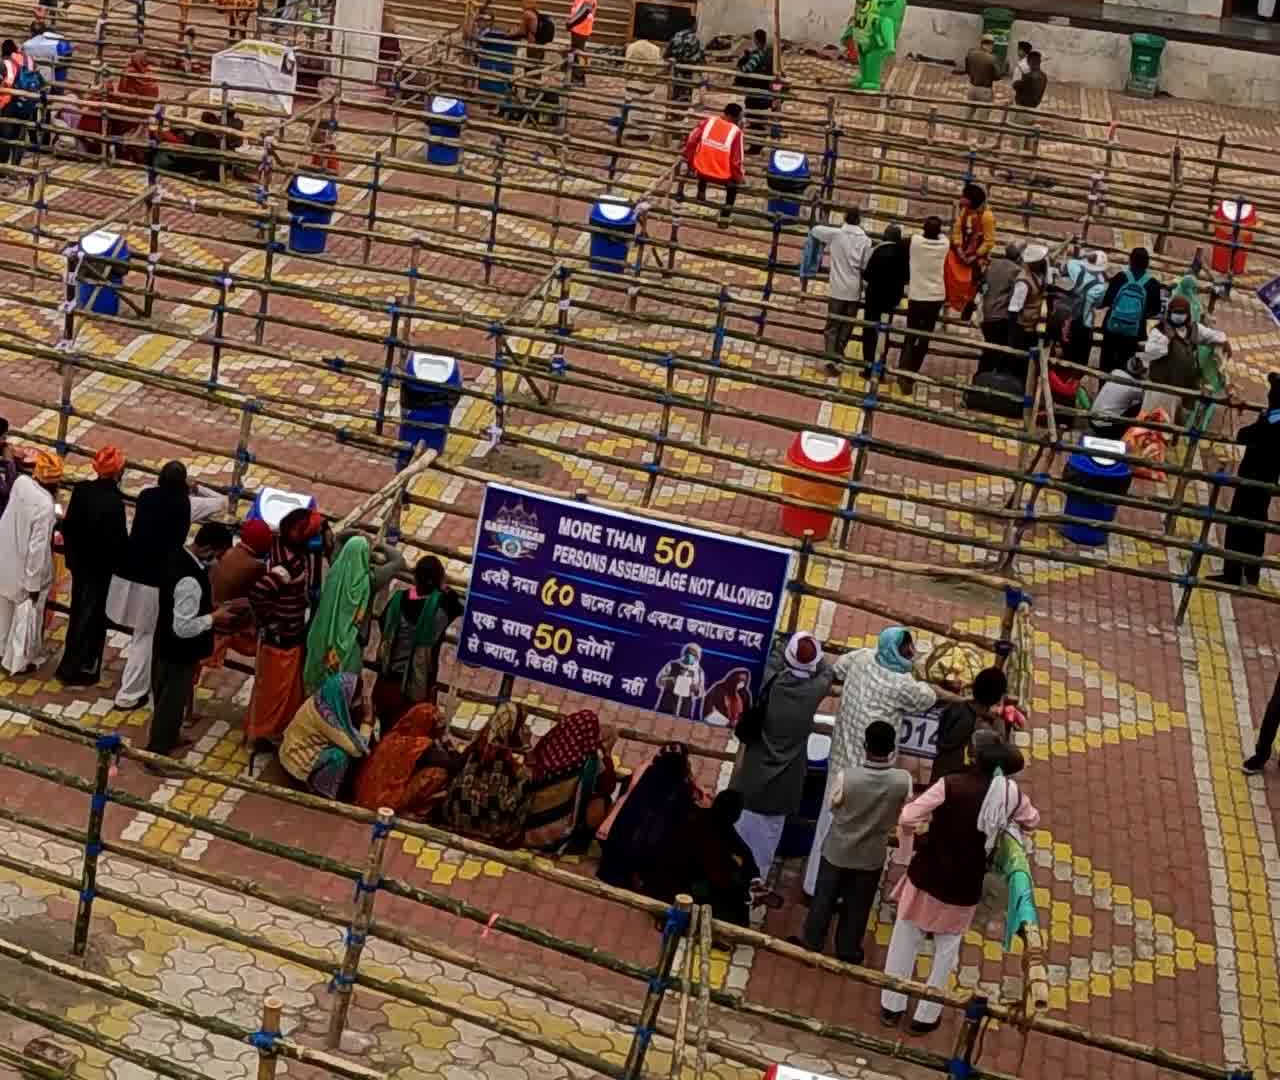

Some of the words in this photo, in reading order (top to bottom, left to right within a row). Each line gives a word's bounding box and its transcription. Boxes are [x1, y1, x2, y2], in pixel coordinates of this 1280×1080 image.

[558, 517, 603, 544] MORE
[605, 527, 647, 554] THAN
[653, 536, 695, 568] 50
[480, 566, 511, 591] একই
[511, 575, 539, 596] সময়
[541, 577, 575, 606] ৫০
[580, 593, 615, 615] জনের
[552, 545, 608, 574] PERSONS
[607, 557, 688, 592] ASSEMBLAGE
[688, 575, 716, 598] NOT
[714, 582, 774, 610] ALLOWED
[471, 610, 498, 631] एक
[502, 618, 533, 641] साथ
[533, 623, 573, 655] 50
[576, 635, 615, 662] लोगों
[467, 633, 481, 653] से
[525, 648, 558, 674] किसी
[562, 660, 578, 680] भी
[581, 667, 614, 689] समय
[621, 676, 648, 696] नहीं
